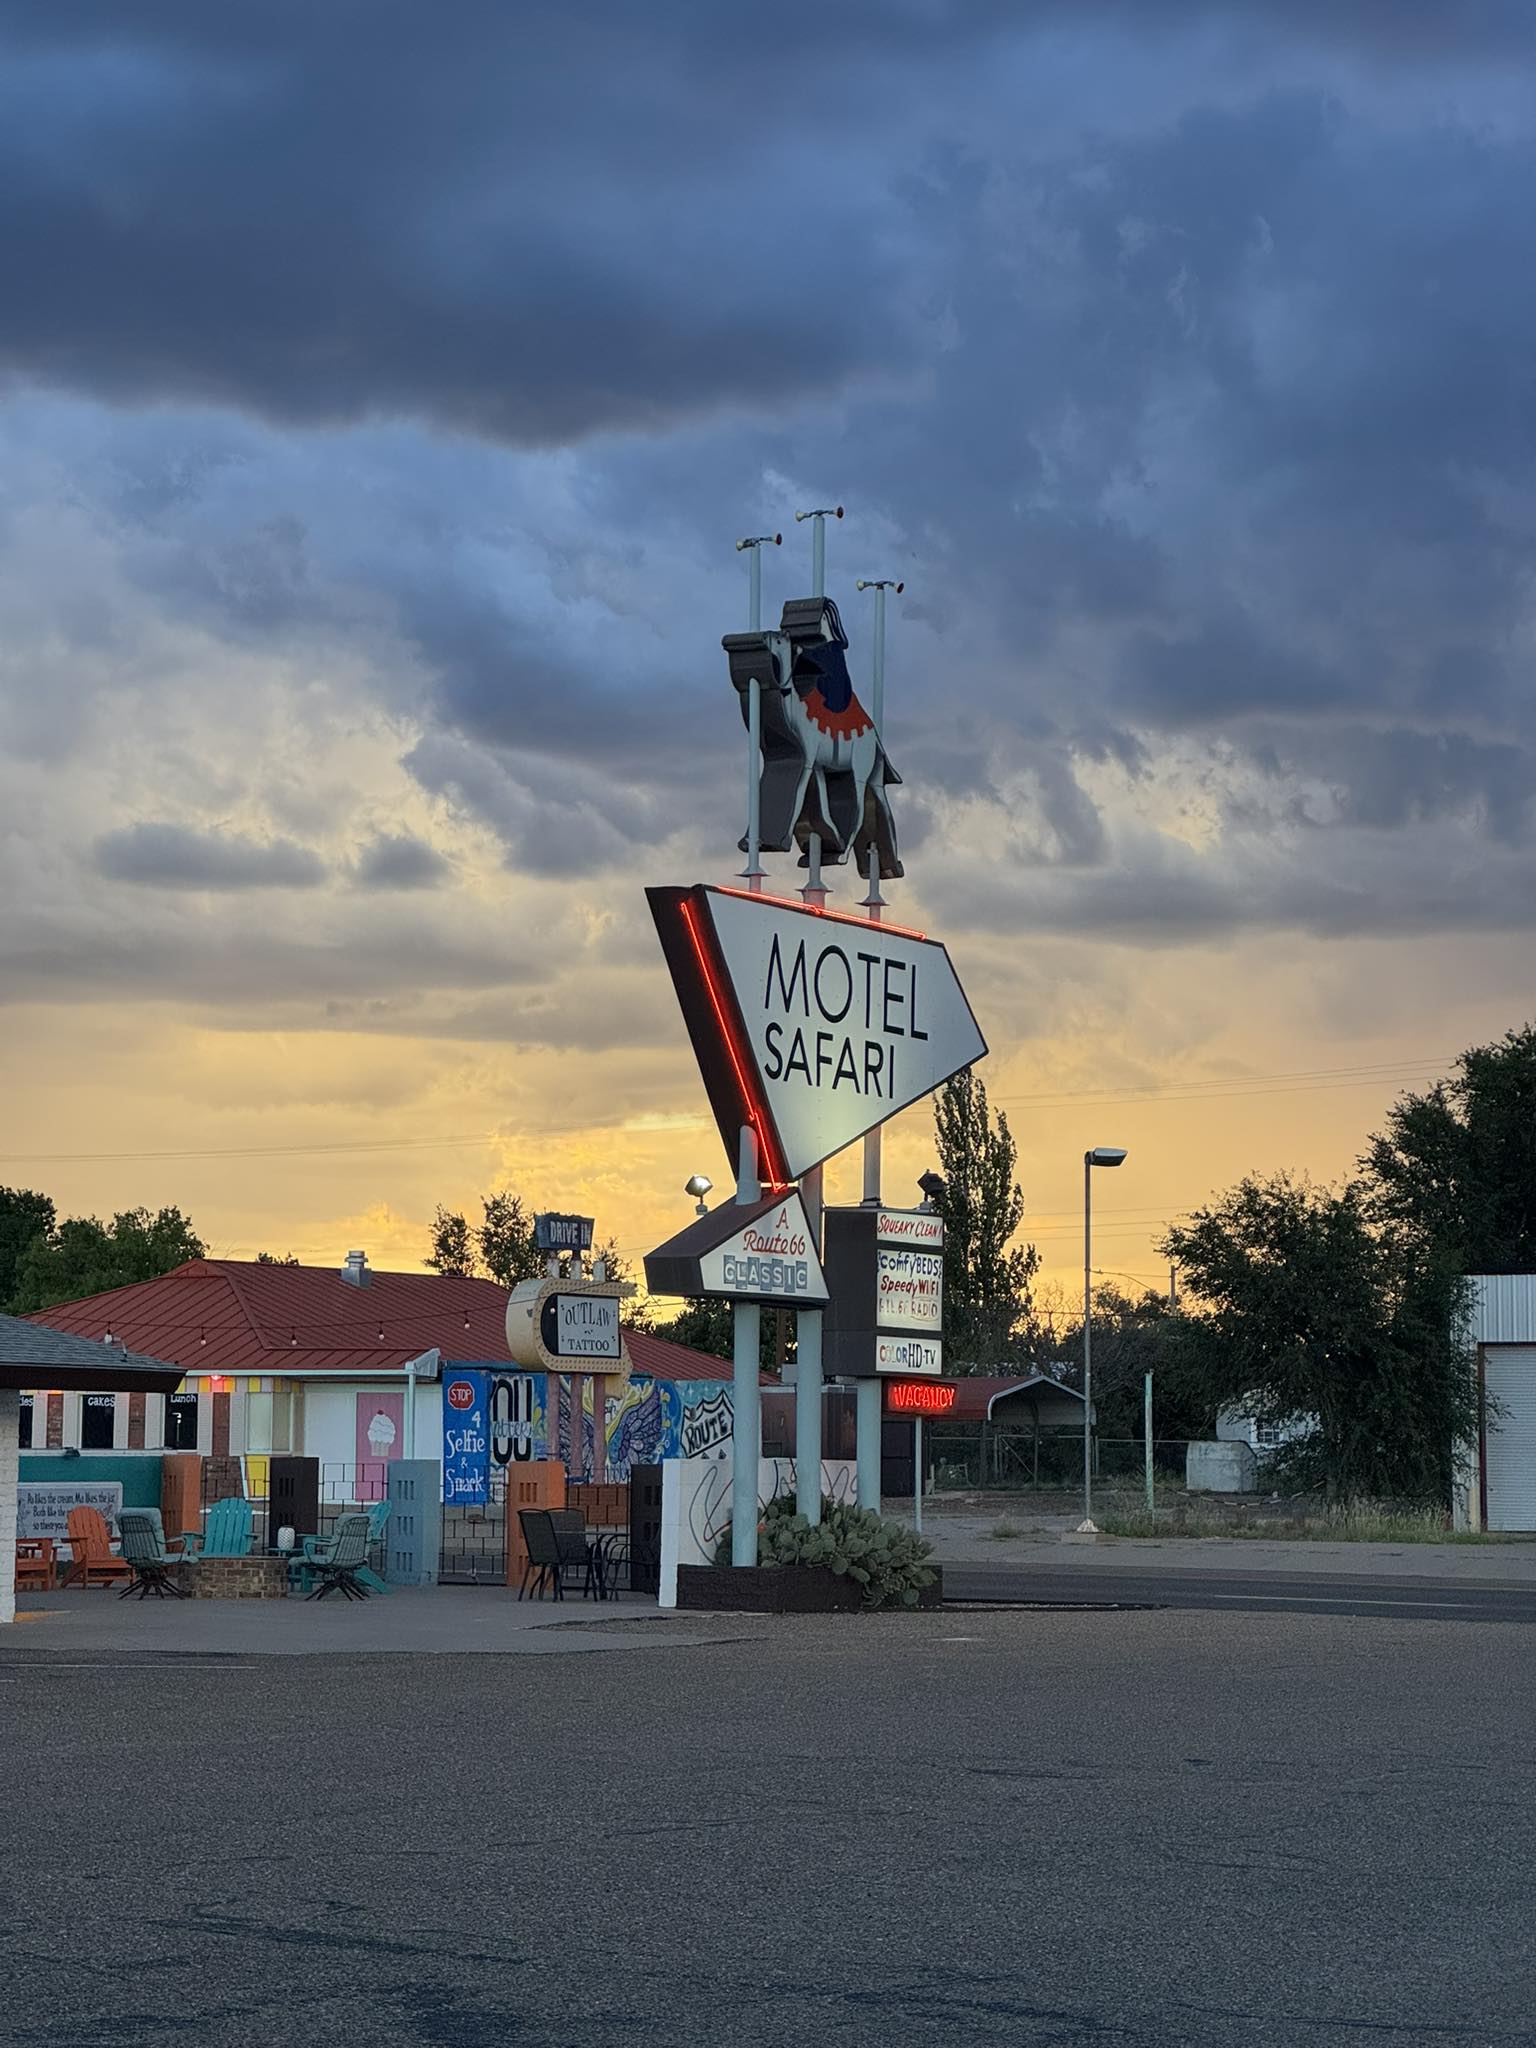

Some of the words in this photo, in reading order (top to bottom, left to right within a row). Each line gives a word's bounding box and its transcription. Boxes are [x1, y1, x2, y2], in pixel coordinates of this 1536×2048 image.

[765, 933, 929, 1041] MOTEL
[764, 1022, 895, 1099] SAFARI
[776, 1207, 789, 1229] A
[878, 1214, 915, 1236] SQUEAKY
[550, 1221, 578, 1244] DRIVE
[580, 1223, 592, 1245] IN
[743, 1229, 788, 1255] Route
[790, 1233, 806, 1255] 66
[916, 1257, 939, 1277] BEDS
[881, 1275, 918, 1297] Speedy
[565, 1301, 610, 1327] OUTLAW
[568, 1338, 610, 1352] TATTOO
[170, 1394, 197, 1403] Lunch
[450, 1388, 472, 1401] STOP
[893, 1384, 955, 1408] VACANCY
[472, 1410, 481, 1428] 4
[685, 1410, 729, 1454] ROUTE
[446, 1429, 486, 1459] Selfie
[461, 1457, 468, 1469] &
[446, 1468, 485, 1498] Snack
